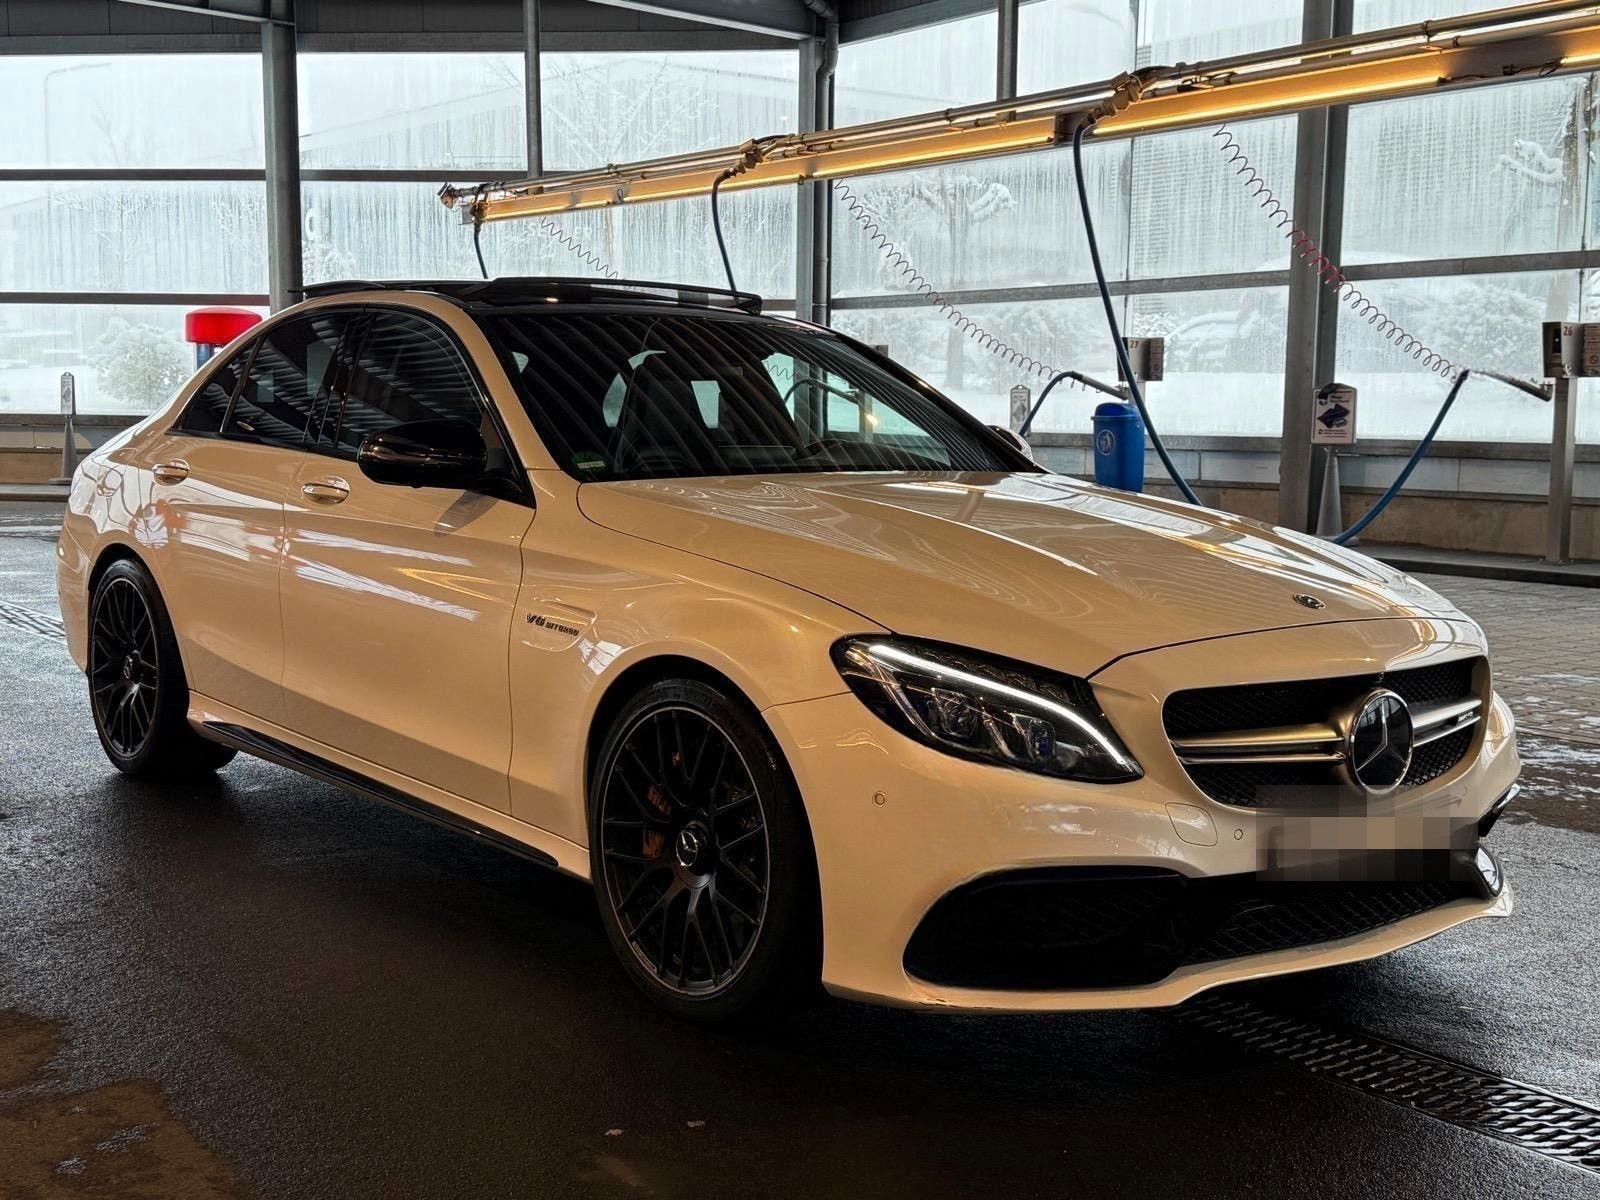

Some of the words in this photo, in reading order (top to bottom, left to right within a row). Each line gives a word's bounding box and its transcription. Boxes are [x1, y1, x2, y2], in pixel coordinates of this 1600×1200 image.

[1563, 325, 1574, 337] 26
[1129, 340, 1139, 349] 27
[526, 613, 546, 627] V8
